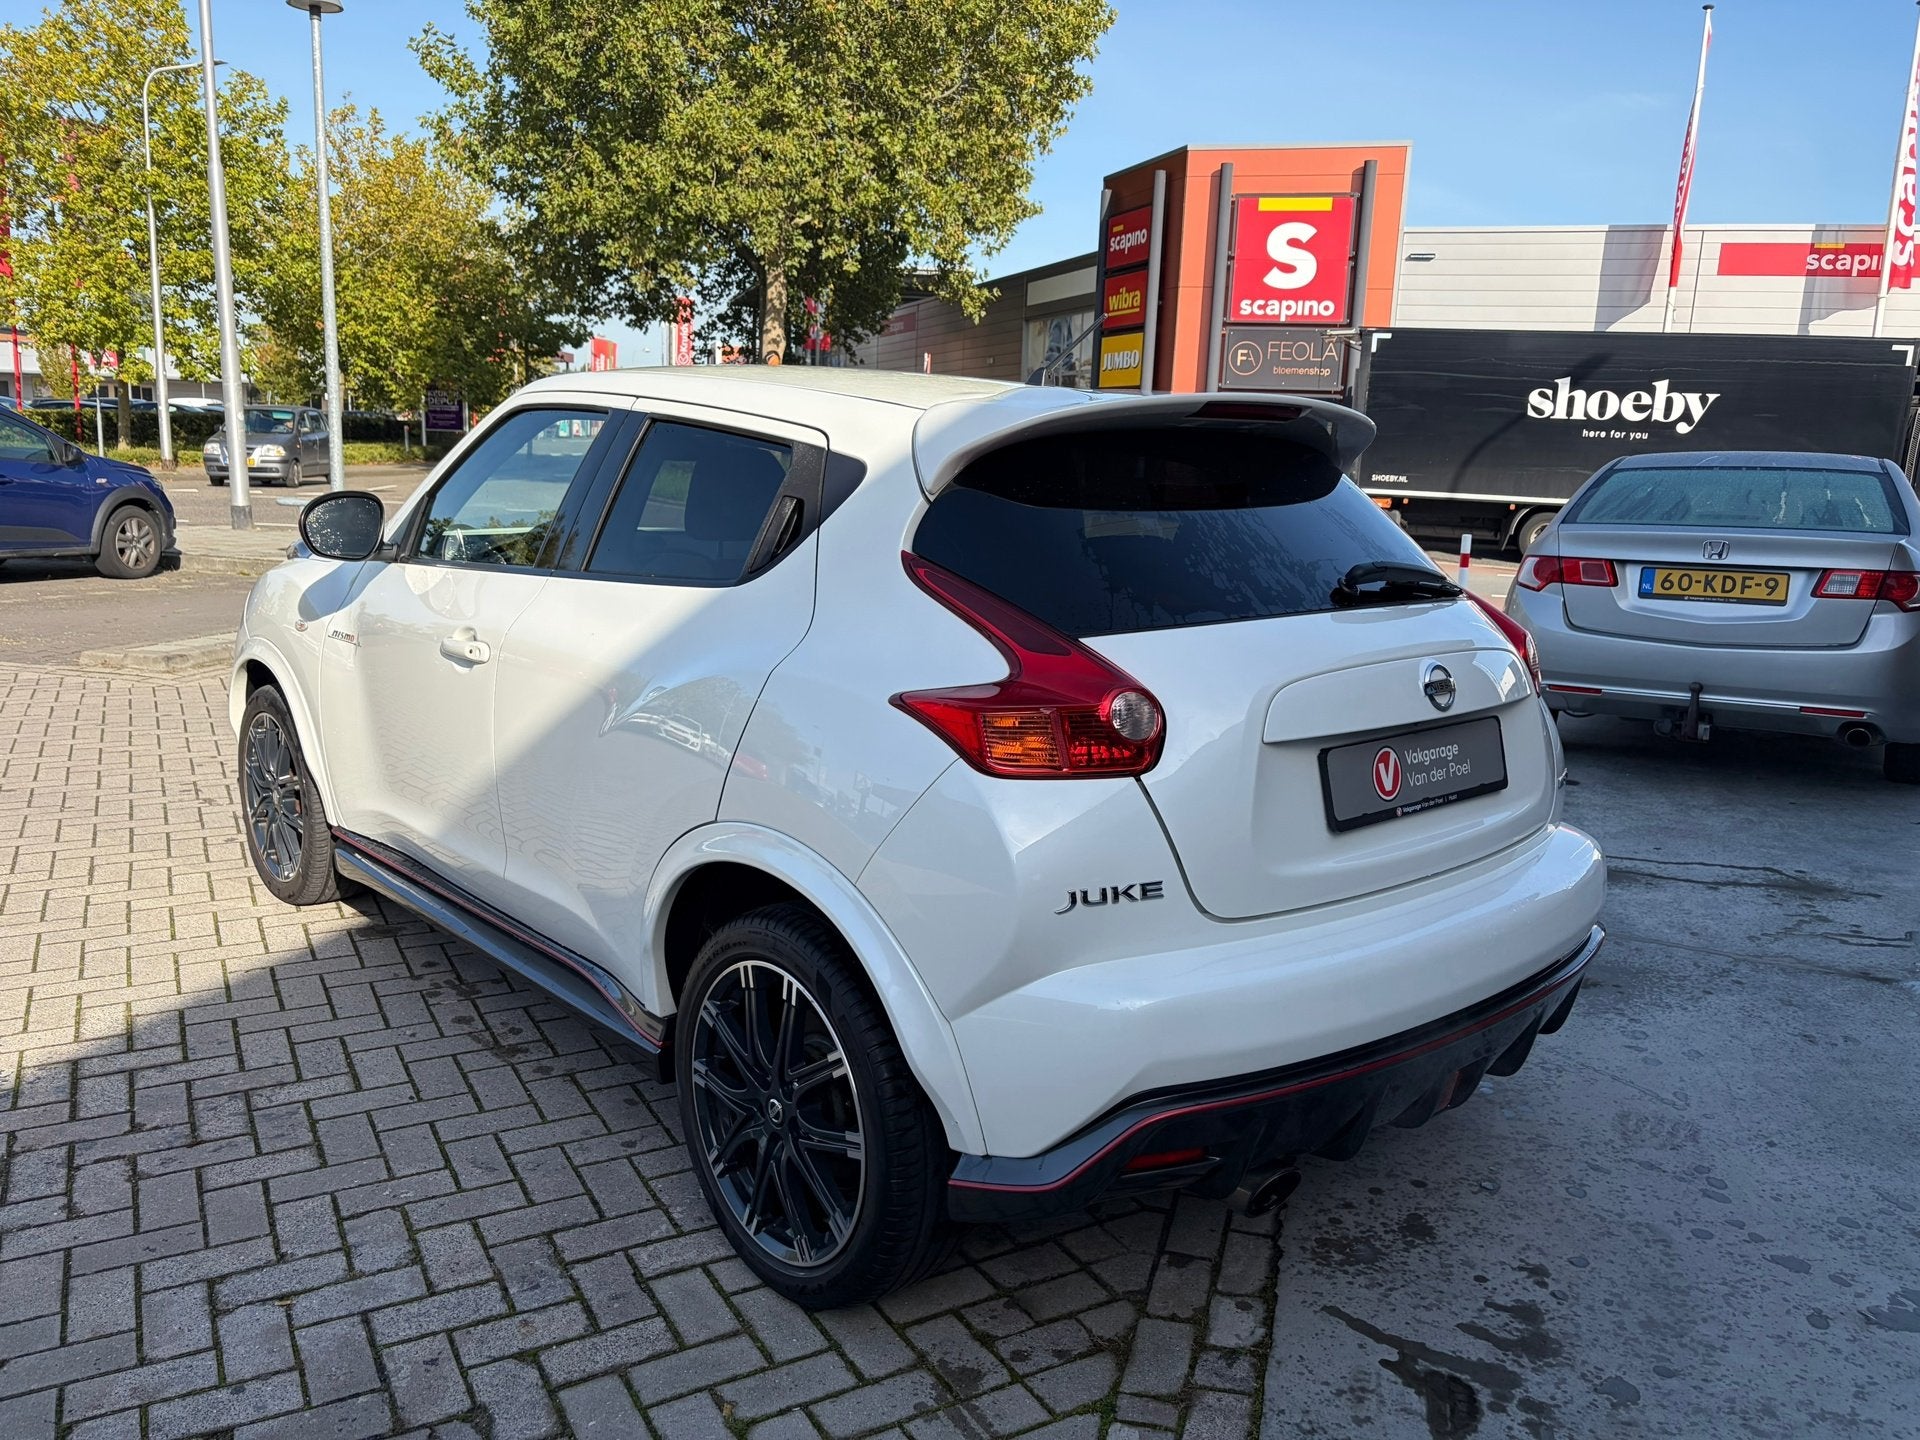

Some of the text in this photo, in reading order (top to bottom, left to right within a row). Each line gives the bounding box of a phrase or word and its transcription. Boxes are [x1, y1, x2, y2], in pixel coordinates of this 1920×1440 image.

[1110, 227, 1148, 255] scapino
[1262, 221, 1318, 290] S
[1109, 286, 1141, 312] wibra
[1239, 299, 1336, 322] scapino
[1101, 350, 1140, 372] JUMBO
[1267, 340, 1339, 362] FEOLA
[1273, 366, 1331, 377] bloemenshop
[1526, 376, 1721, 435] shoeby
[1582, 429, 1649, 440] here for you
[1371, 474, 1408, 482] SHOEBY.NL
[1660, 572, 1780, 597] 60-KDF-9
[1404, 742, 1459, 765] Vakgarage
[1406, 759, 1472, 787] Van der Poel
[1054, 880, 1164, 915] JUKE
